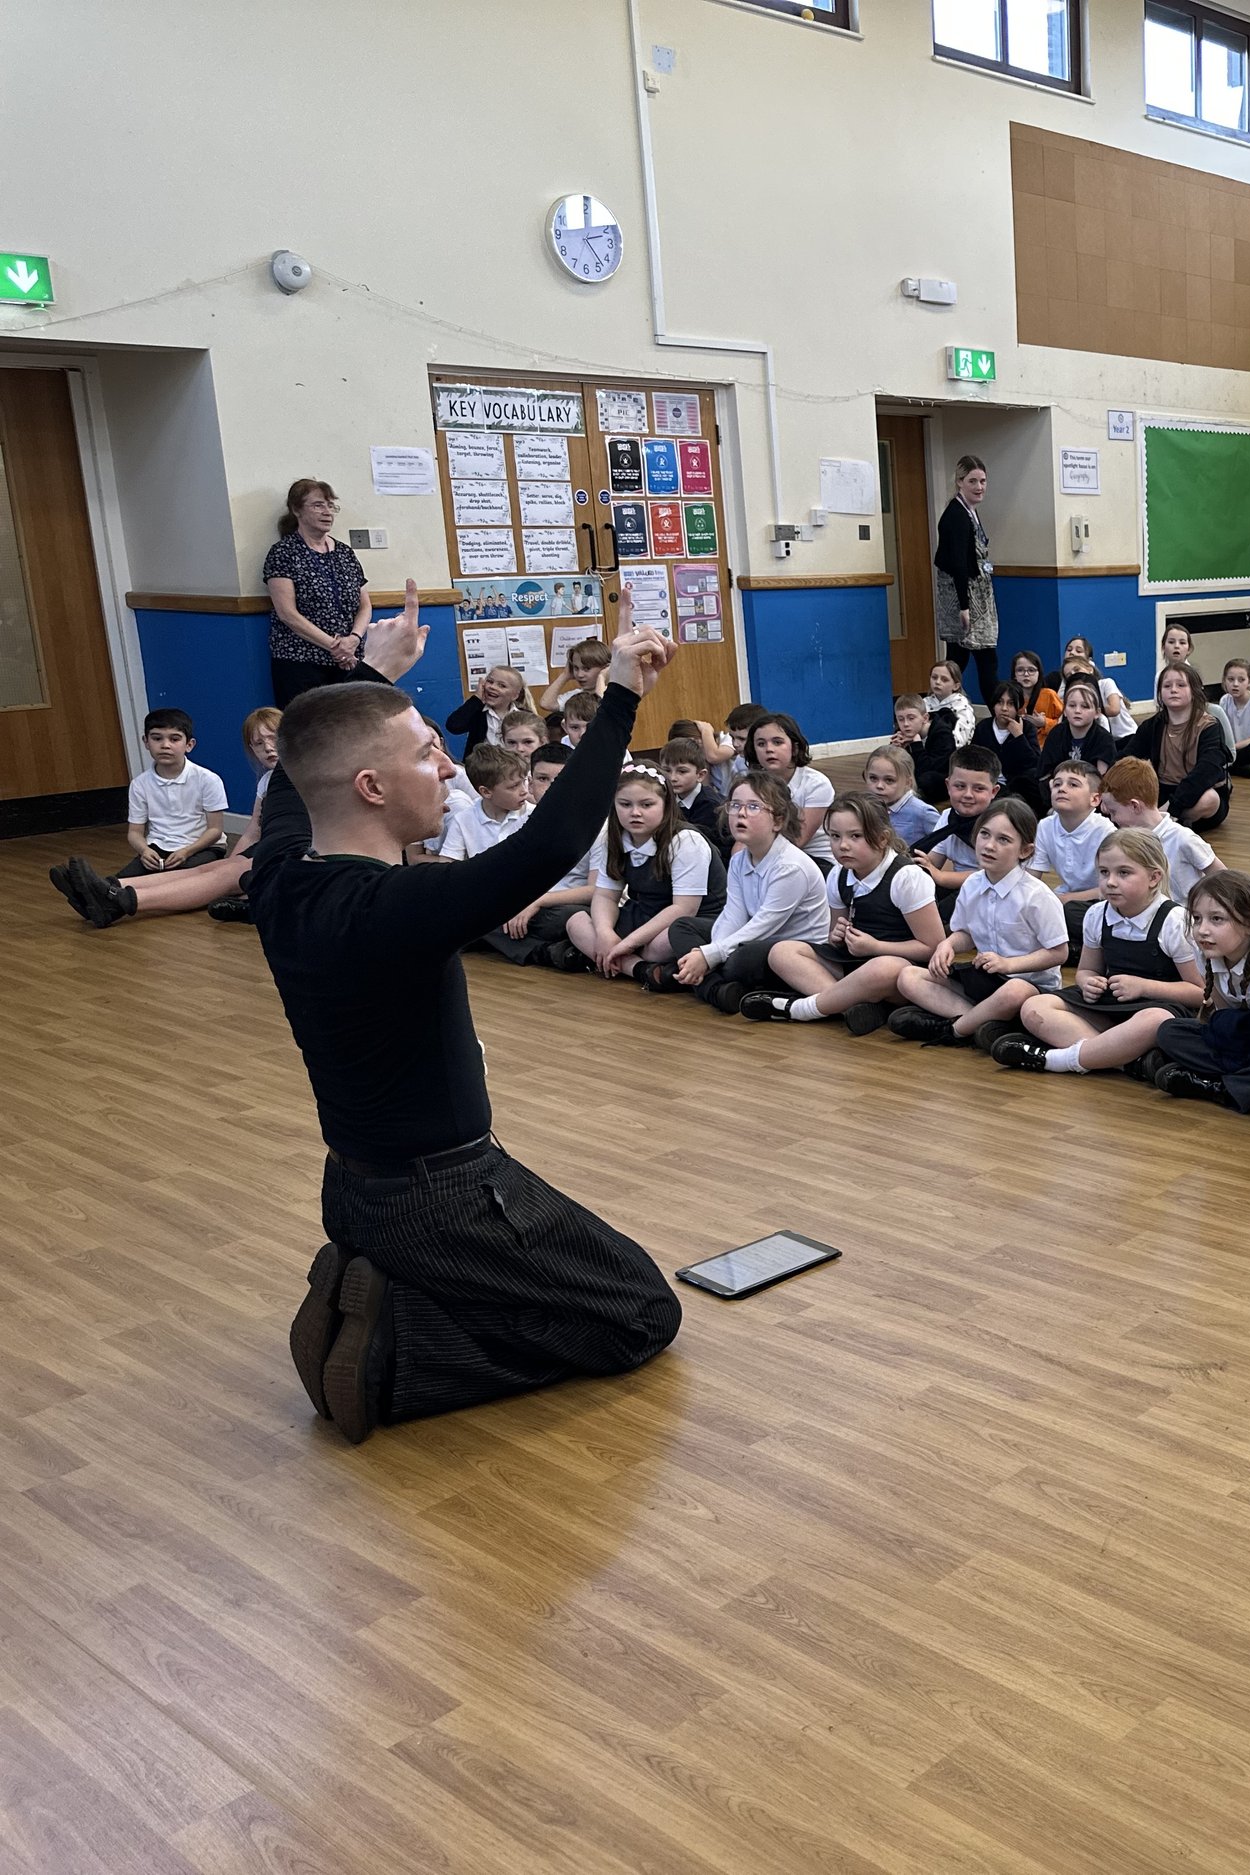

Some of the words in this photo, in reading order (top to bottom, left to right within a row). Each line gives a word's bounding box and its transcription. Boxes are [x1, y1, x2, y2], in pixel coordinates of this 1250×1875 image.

[555, 228, 562, 239] 9
[607, 238, 614, 249] 3
[560, 245, 566, 256] 8
[571, 257, 578, 268] 7
[604, 253, 610, 262] 4
[583, 263, 590, 274] 6
[595, 262, 602, 272] 5
[449, 399, 477, 418] KEY
[483, 401, 571, 423] VOCABULARY
[1113, 425, 1125, 434] Year
[1125, 425, 1130, 434] 2
[511, 592, 549, 603] Respect
